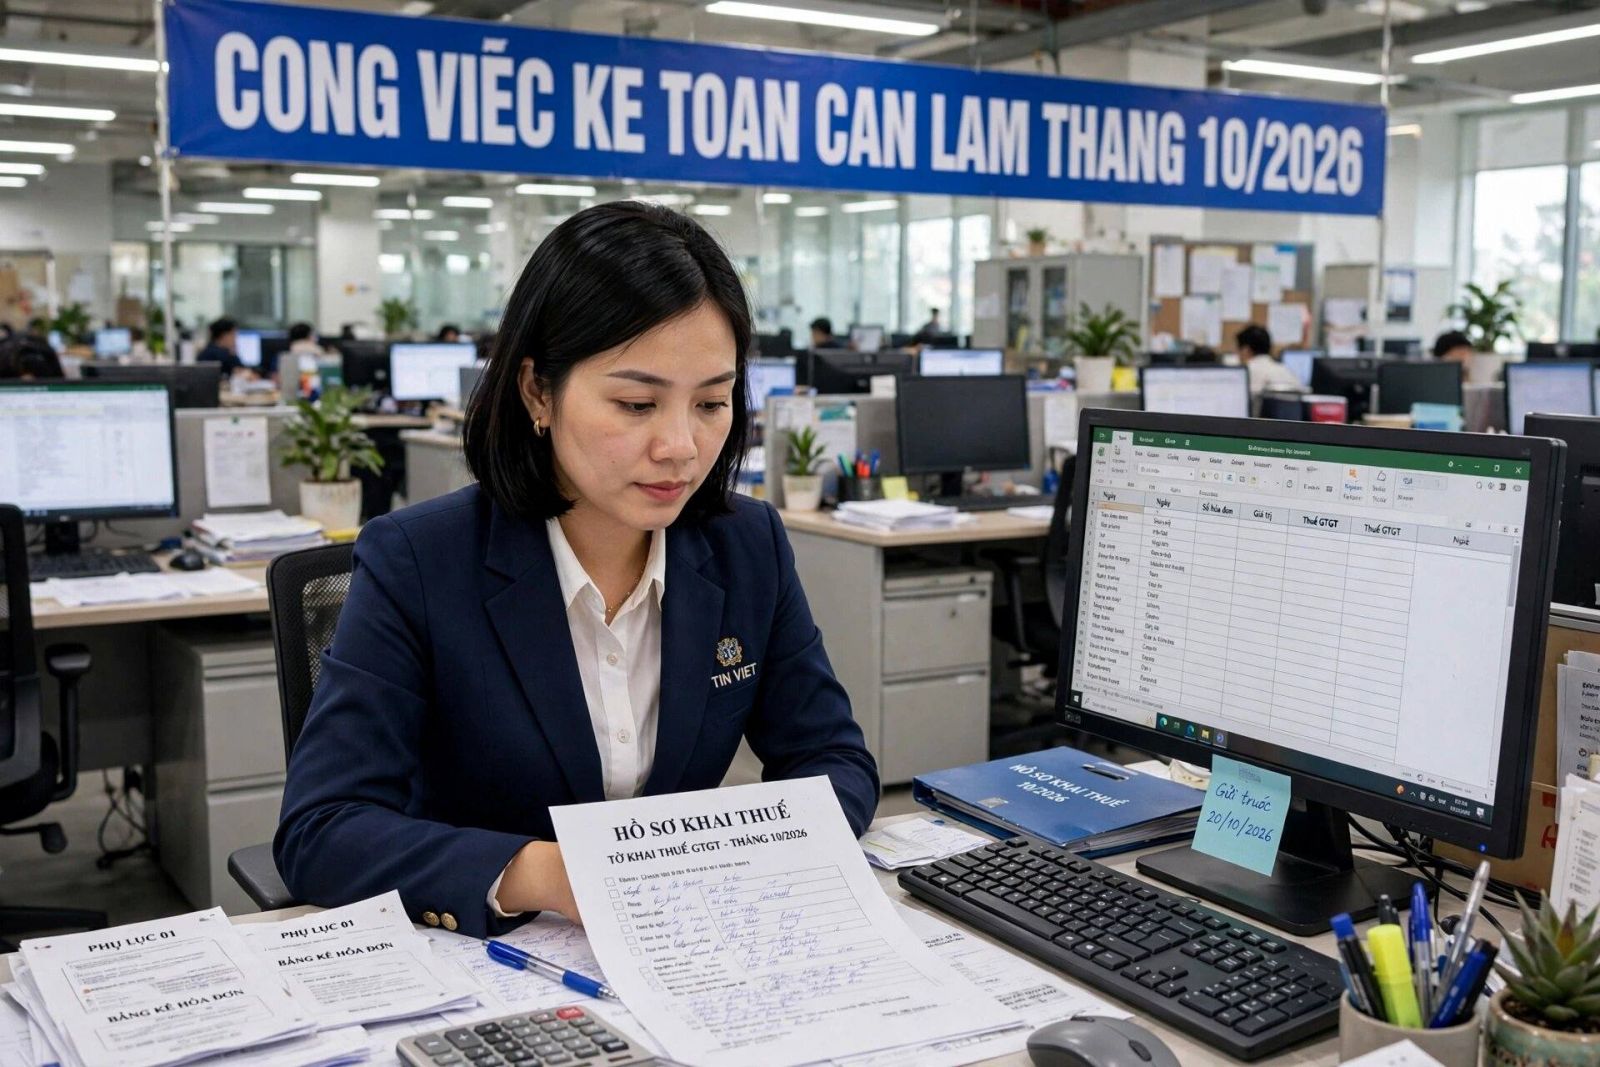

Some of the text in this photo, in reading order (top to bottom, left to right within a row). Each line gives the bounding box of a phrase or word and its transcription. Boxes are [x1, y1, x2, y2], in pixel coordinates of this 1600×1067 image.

[215, 31, 400, 139] CONG
[573, 63, 646, 153] KE
[659, 71, 800, 162] TOAN
[815, 82, 916, 169] CAN
[931, 92, 1030, 177] LAM
[1041, 102, 1186, 186] THANG
[1199, 115, 1363, 197] 10/2026
[1319, 518, 1339, 528] GTGT
[1382, 526, 1401, 536] GTGT
[711, 662, 757, 688] TIN VIET
[1016, 781, 1070, 803] 10/2026
[1048, 778, 1089, 794] KHAI
[613, 798, 791, 841] HỒ SƠ KHAI THUẾ
[1206, 810, 1274, 842] 20/10/2026
[607, 851, 625, 864] TỜ
[627, 849, 656, 862] KHAI
[657, 841, 690, 857] THUẾ
[691, 840, 721, 853] GTGT
[770, 828, 808, 842] 10/2026
[87, 929, 176, 952] PHỤ LỤC 01
[281, 919, 354, 939] PHỤ LỤC 01
